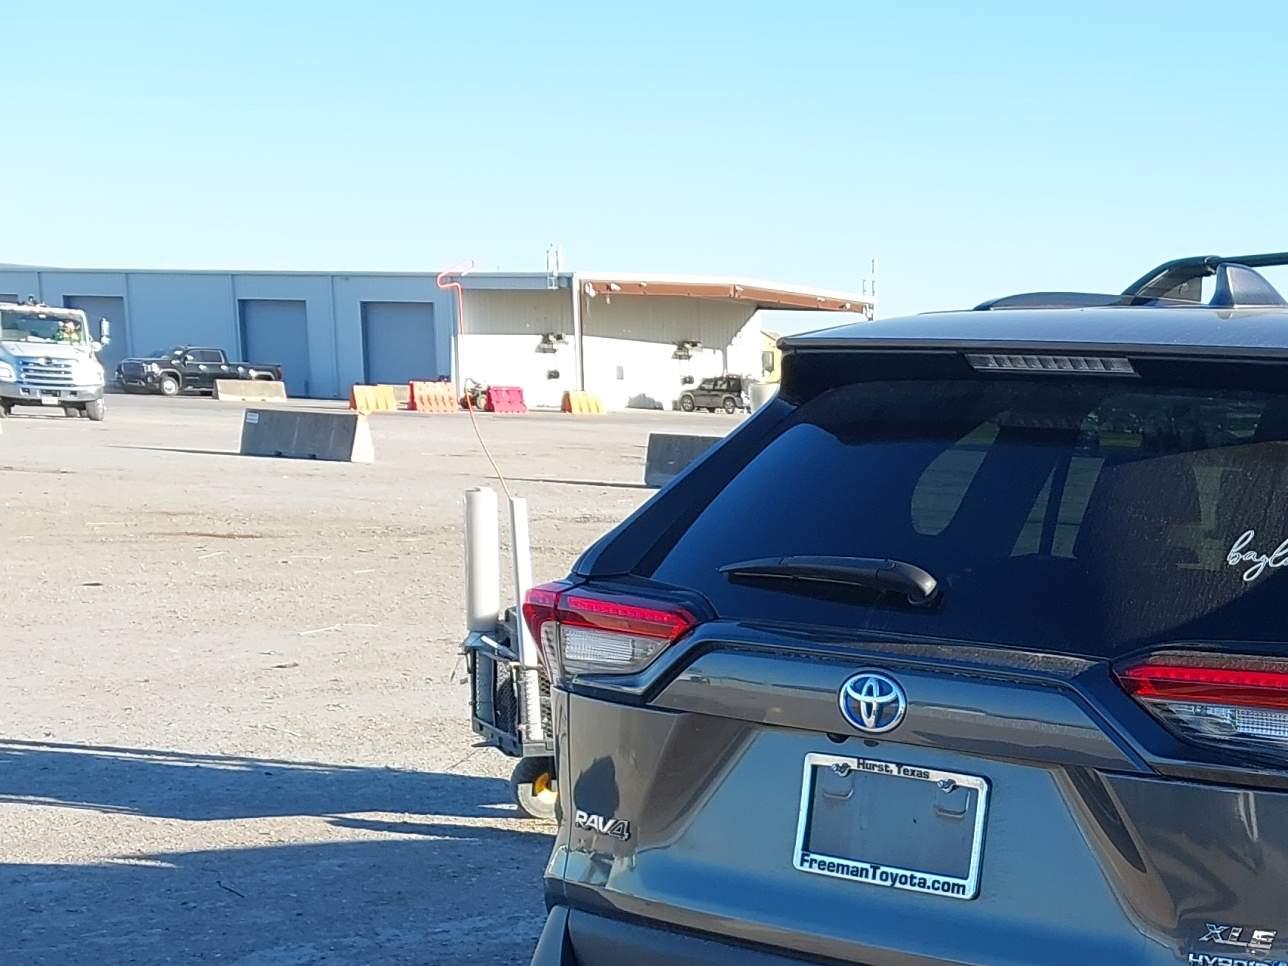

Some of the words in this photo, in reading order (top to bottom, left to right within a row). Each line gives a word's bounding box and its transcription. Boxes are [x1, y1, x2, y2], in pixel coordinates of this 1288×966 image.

[856, 758, 894, 774] Hurst,
[896, 764, 931, 779] Texas
[575, 810, 631, 841] RAV4
[800, 852, 967, 896] FreemanToyota.com
[1198, 922, 1278, 950] XLE
